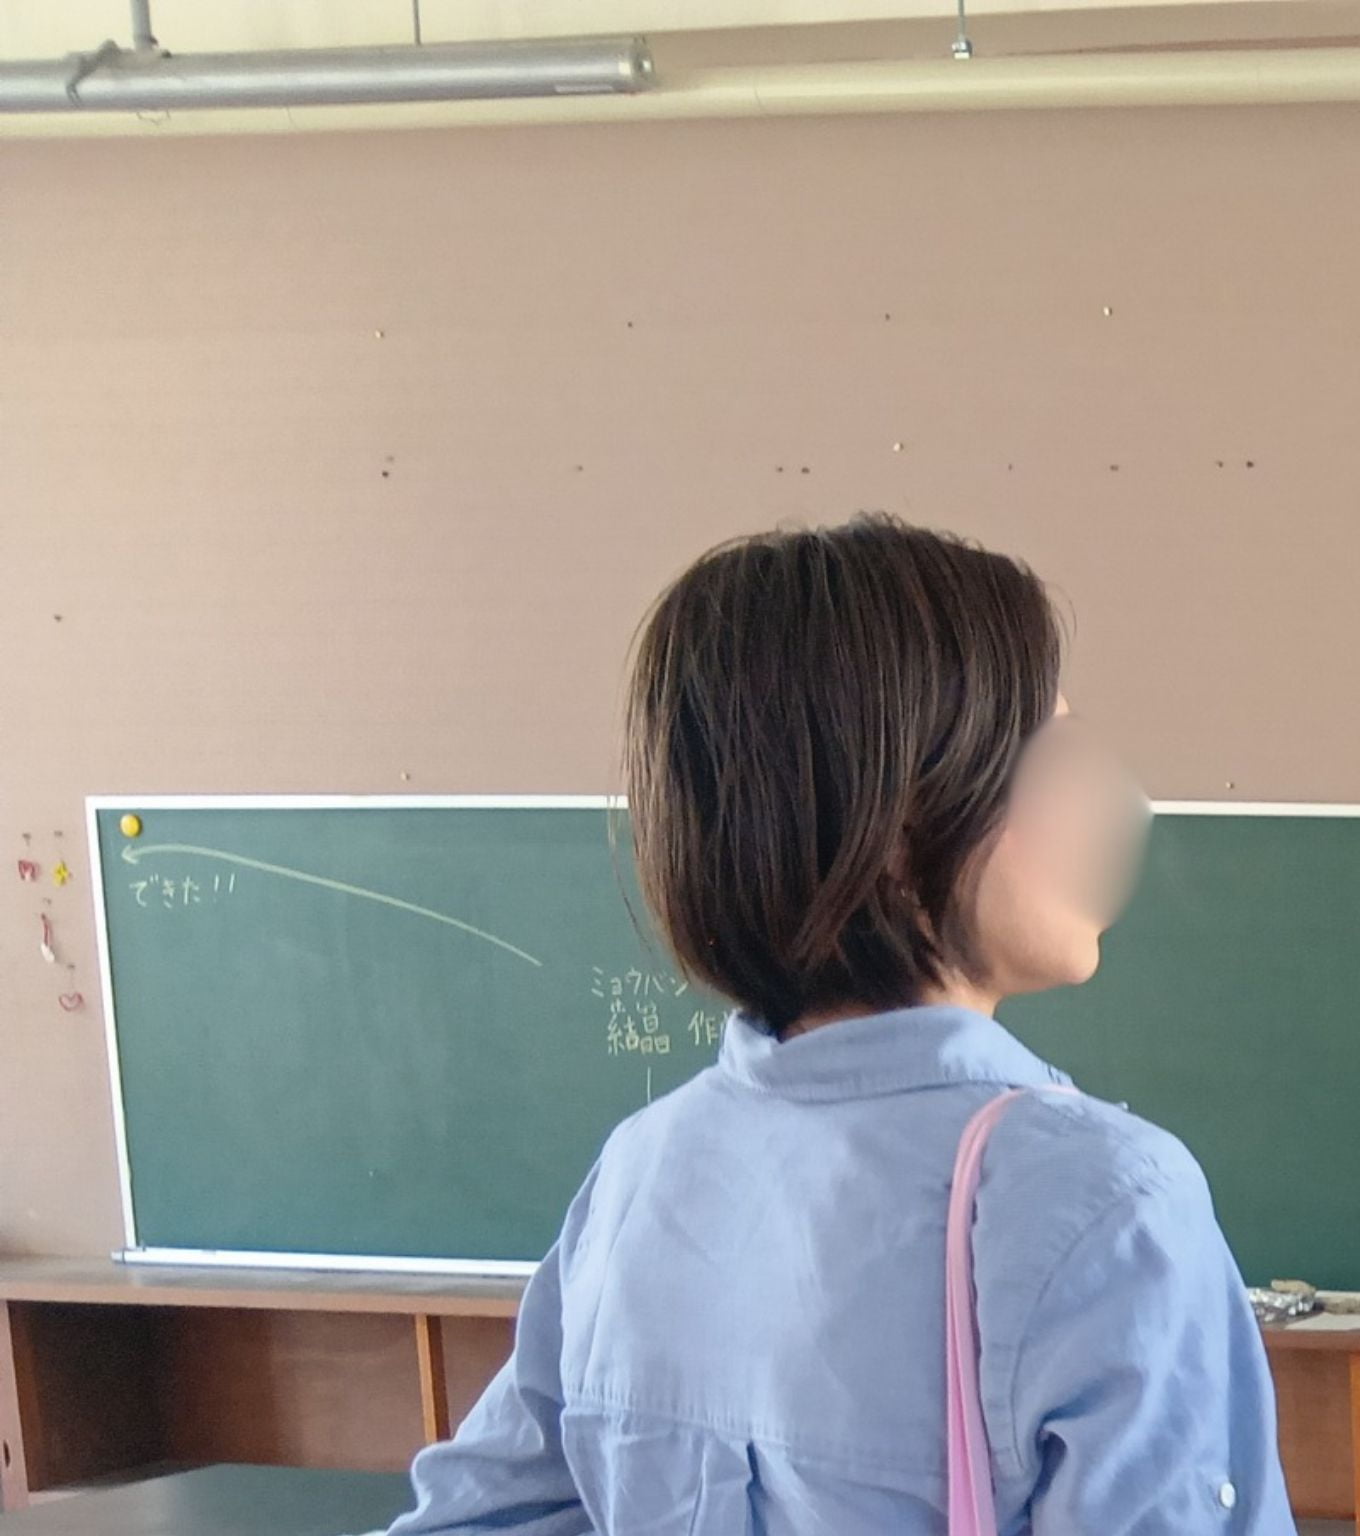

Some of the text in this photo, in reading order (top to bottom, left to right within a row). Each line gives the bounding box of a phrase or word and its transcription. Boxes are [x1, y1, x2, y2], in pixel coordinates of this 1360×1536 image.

[591, 966, 689, 998] ミョウバン
[607, 1009, 728, 1056] 結晶 作
